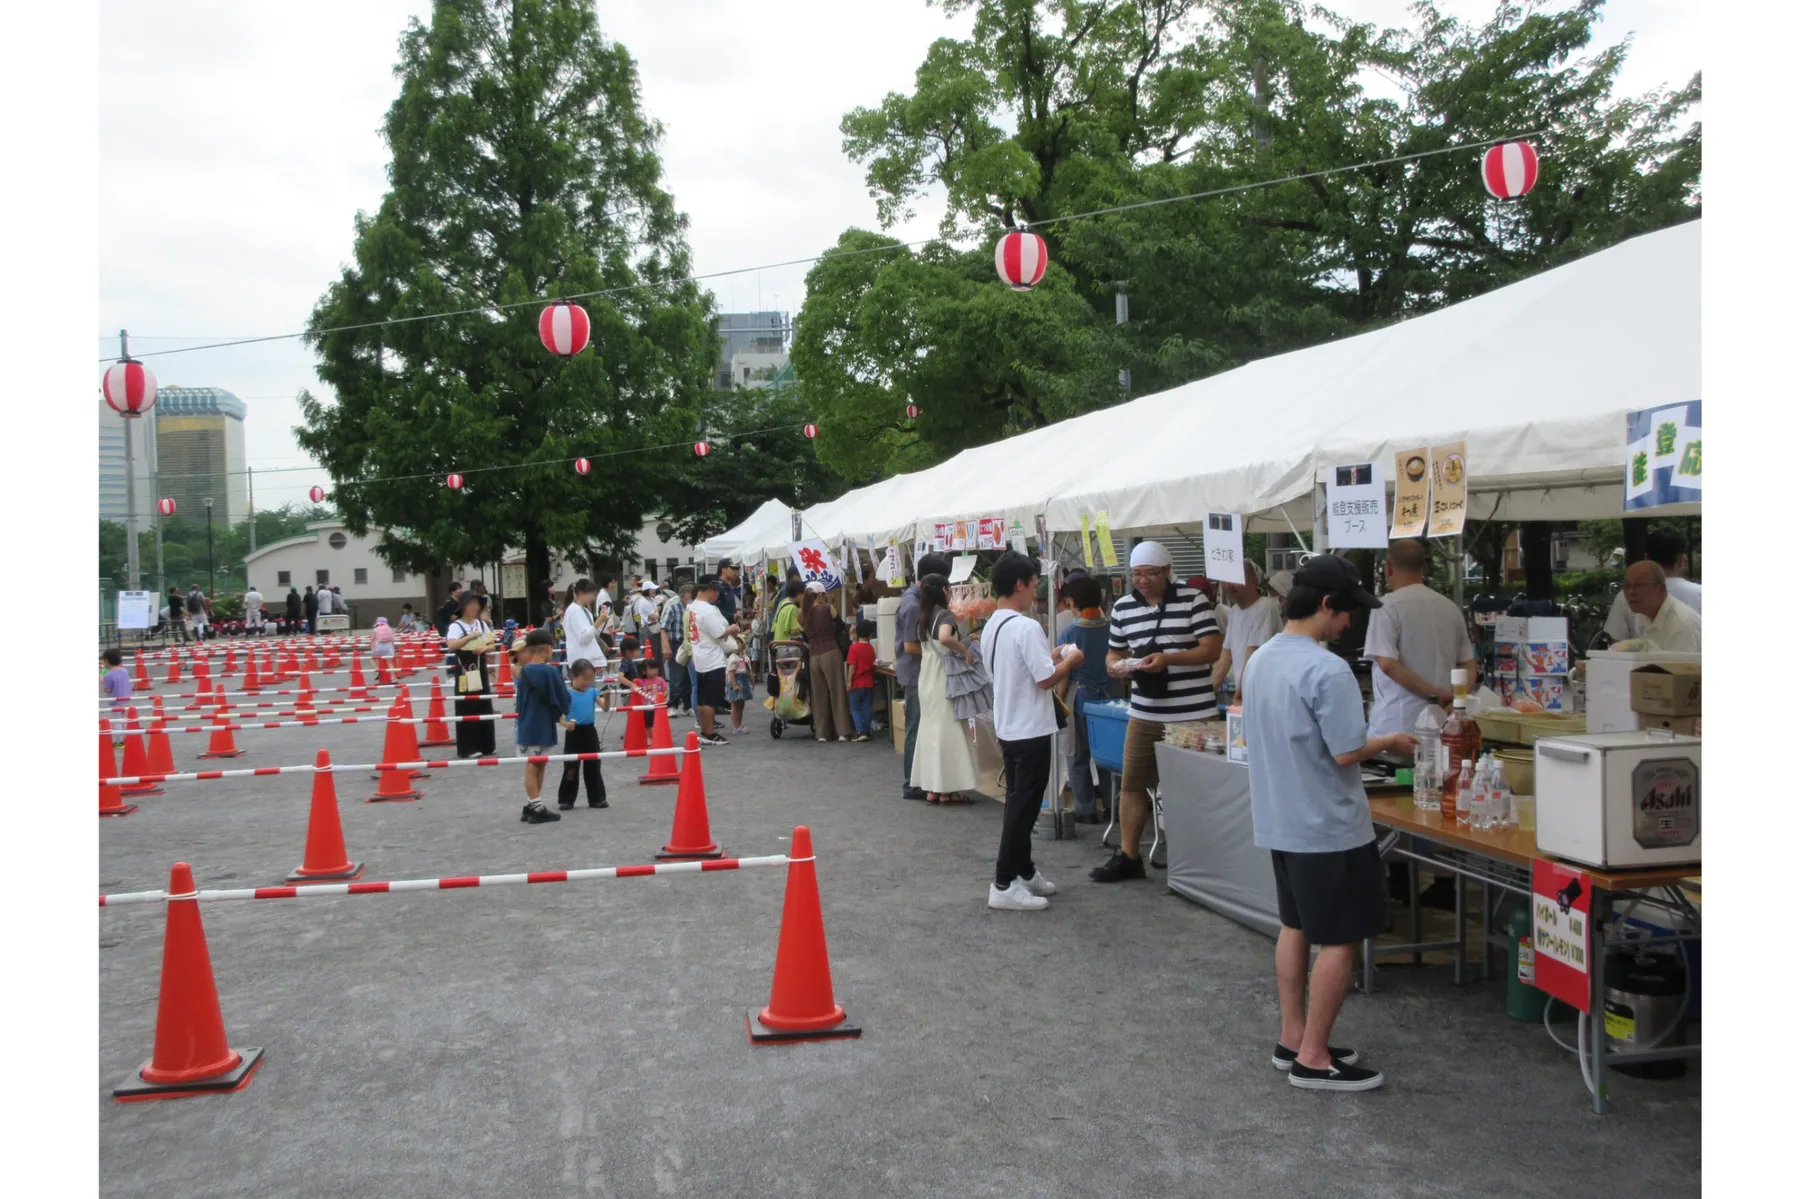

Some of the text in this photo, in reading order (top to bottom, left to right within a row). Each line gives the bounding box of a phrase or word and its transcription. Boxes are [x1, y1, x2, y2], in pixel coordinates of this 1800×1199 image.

[1332, 499, 1379, 517] 能登支援販売
[1344, 519, 1367, 534] ブース
[797, 547, 827, 575] 氷
[1640, 784, 1692, 812] Asahi
[1660, 819, 1674, 829] 生
